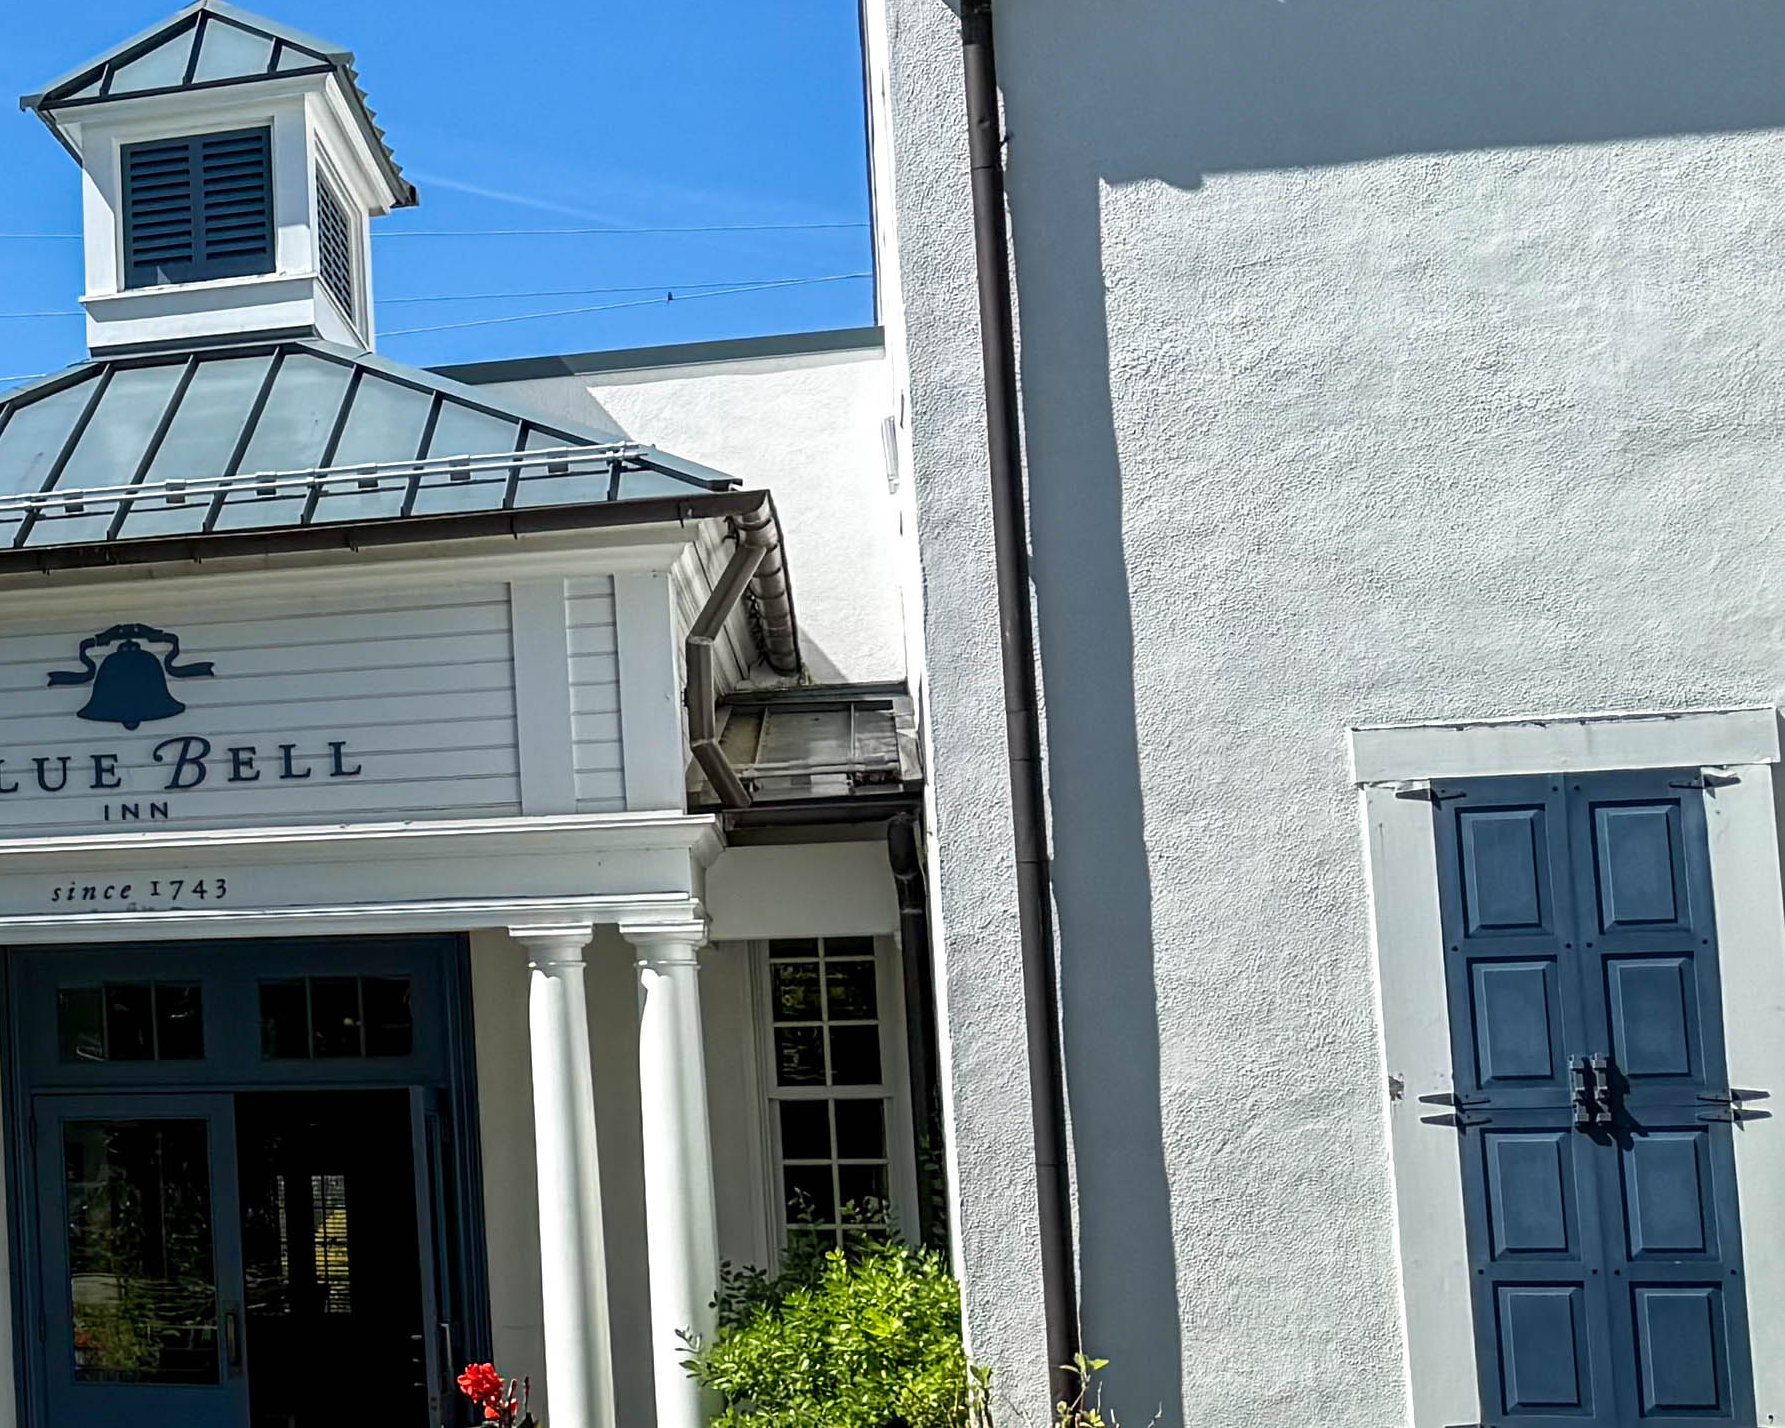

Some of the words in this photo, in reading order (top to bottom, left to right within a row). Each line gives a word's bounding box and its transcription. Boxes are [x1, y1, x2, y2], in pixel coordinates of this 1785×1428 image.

[152, 735, 363, 792] BELL
[103, 802, 170, 822] INN
[51, 882, 133, 903] since
[149, 878, 229, 900] 1743
